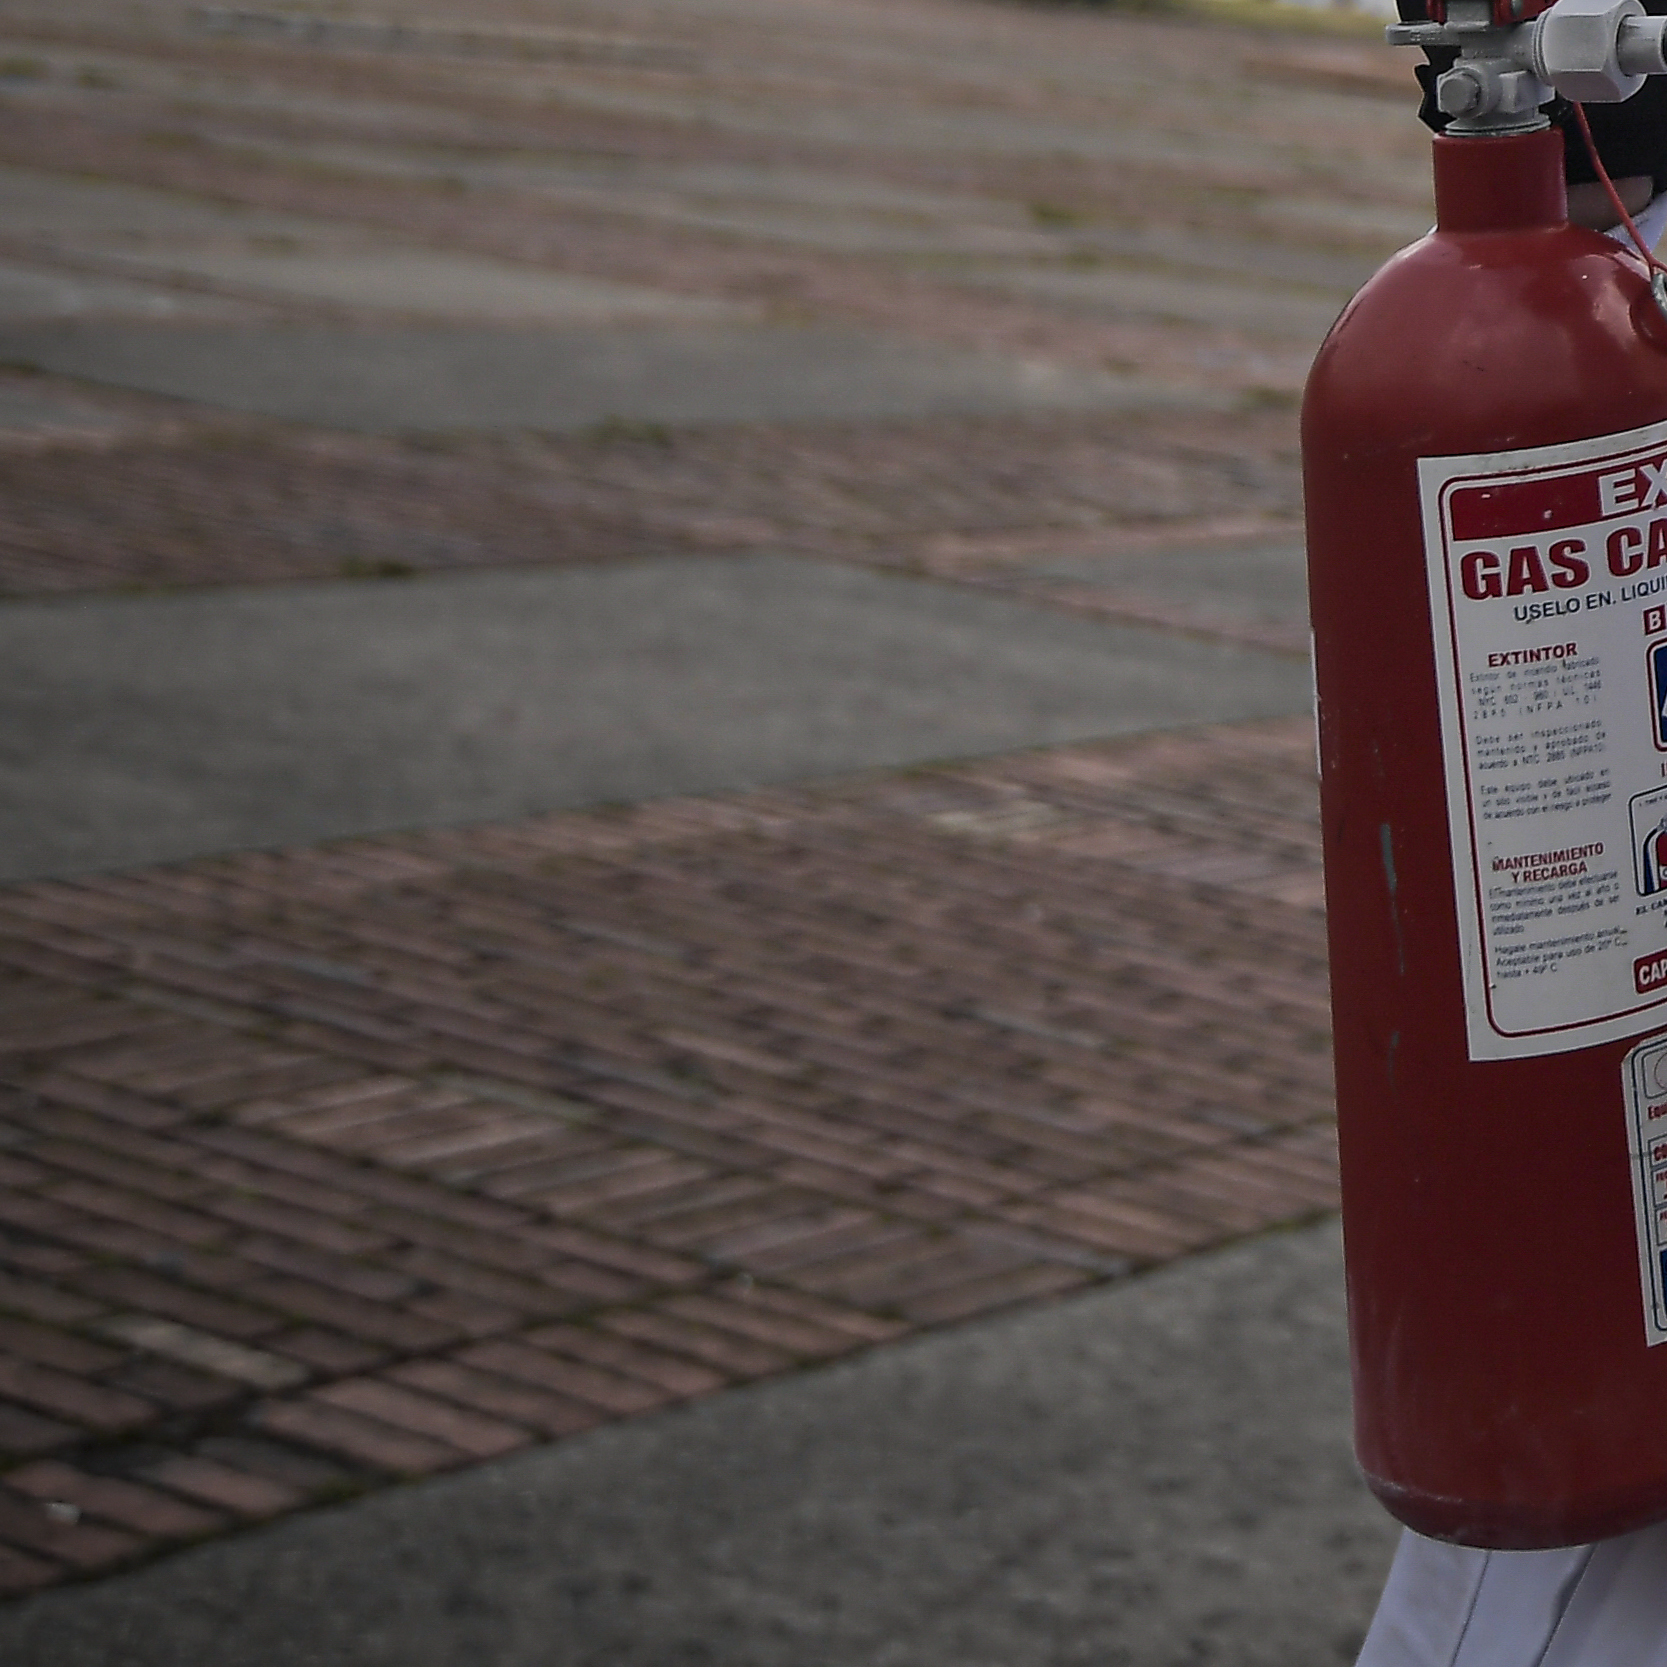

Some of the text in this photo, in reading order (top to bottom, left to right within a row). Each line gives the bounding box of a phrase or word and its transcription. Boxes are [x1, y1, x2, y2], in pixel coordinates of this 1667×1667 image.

[1460, 538, 1592, 601] GAS
[1514, 596, 1581, 622] USELO
[1649, 609, 1662, 631] B
[1488, 642, 1578, 668] EXTINTOR
[1492, 842, 1604, 872] MANTENIMIENTO
[1511, 861, 1588, 884] Y RECARGA
